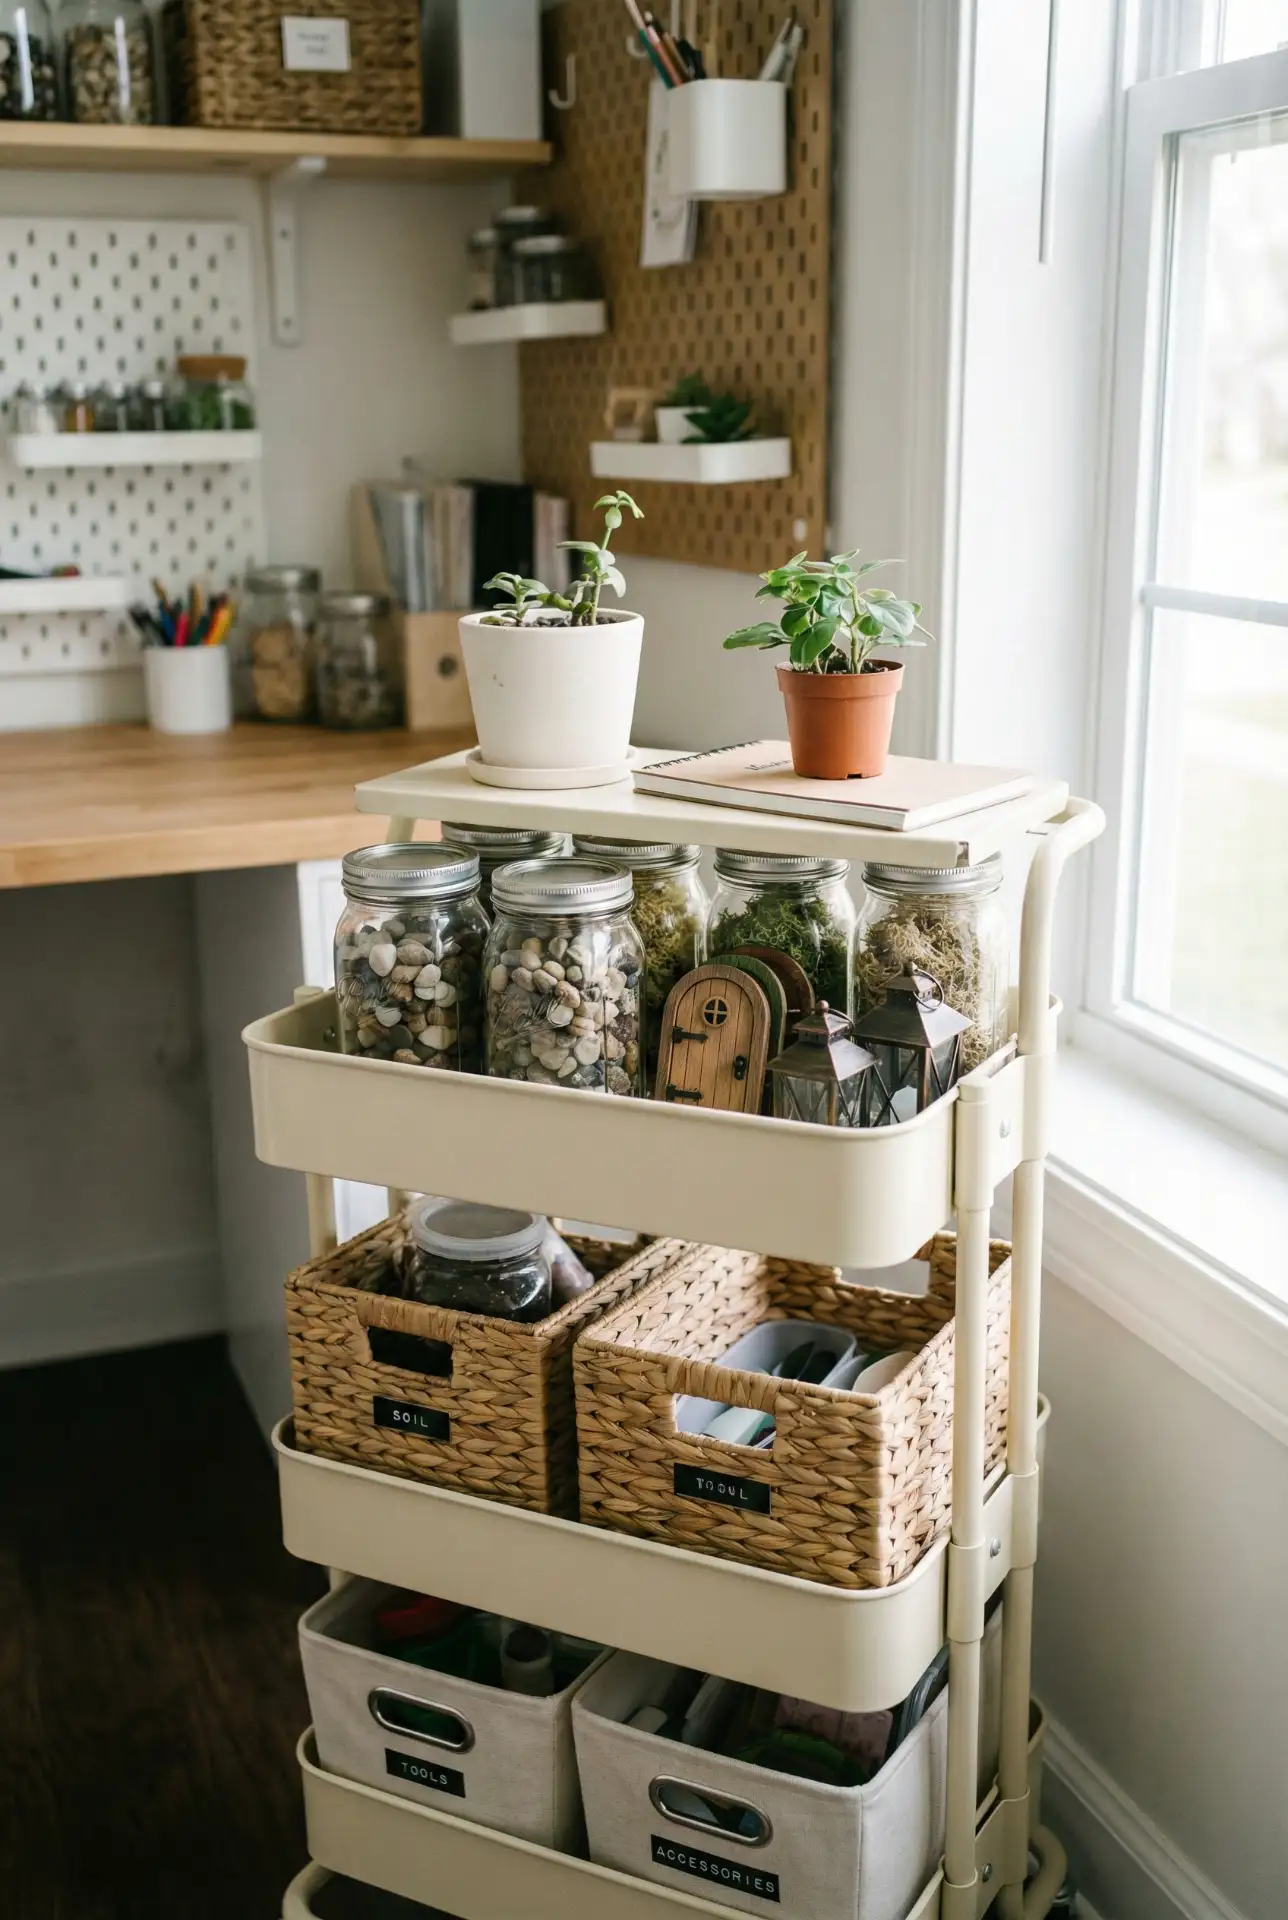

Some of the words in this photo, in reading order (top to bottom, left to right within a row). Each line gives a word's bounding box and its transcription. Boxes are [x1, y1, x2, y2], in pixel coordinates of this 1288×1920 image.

[393, 1409, 429, 1429] SOIL
[401, 1762, 448, 1785] TOOLS
[656, 1846, 775, 1893] ACCESSORIES
